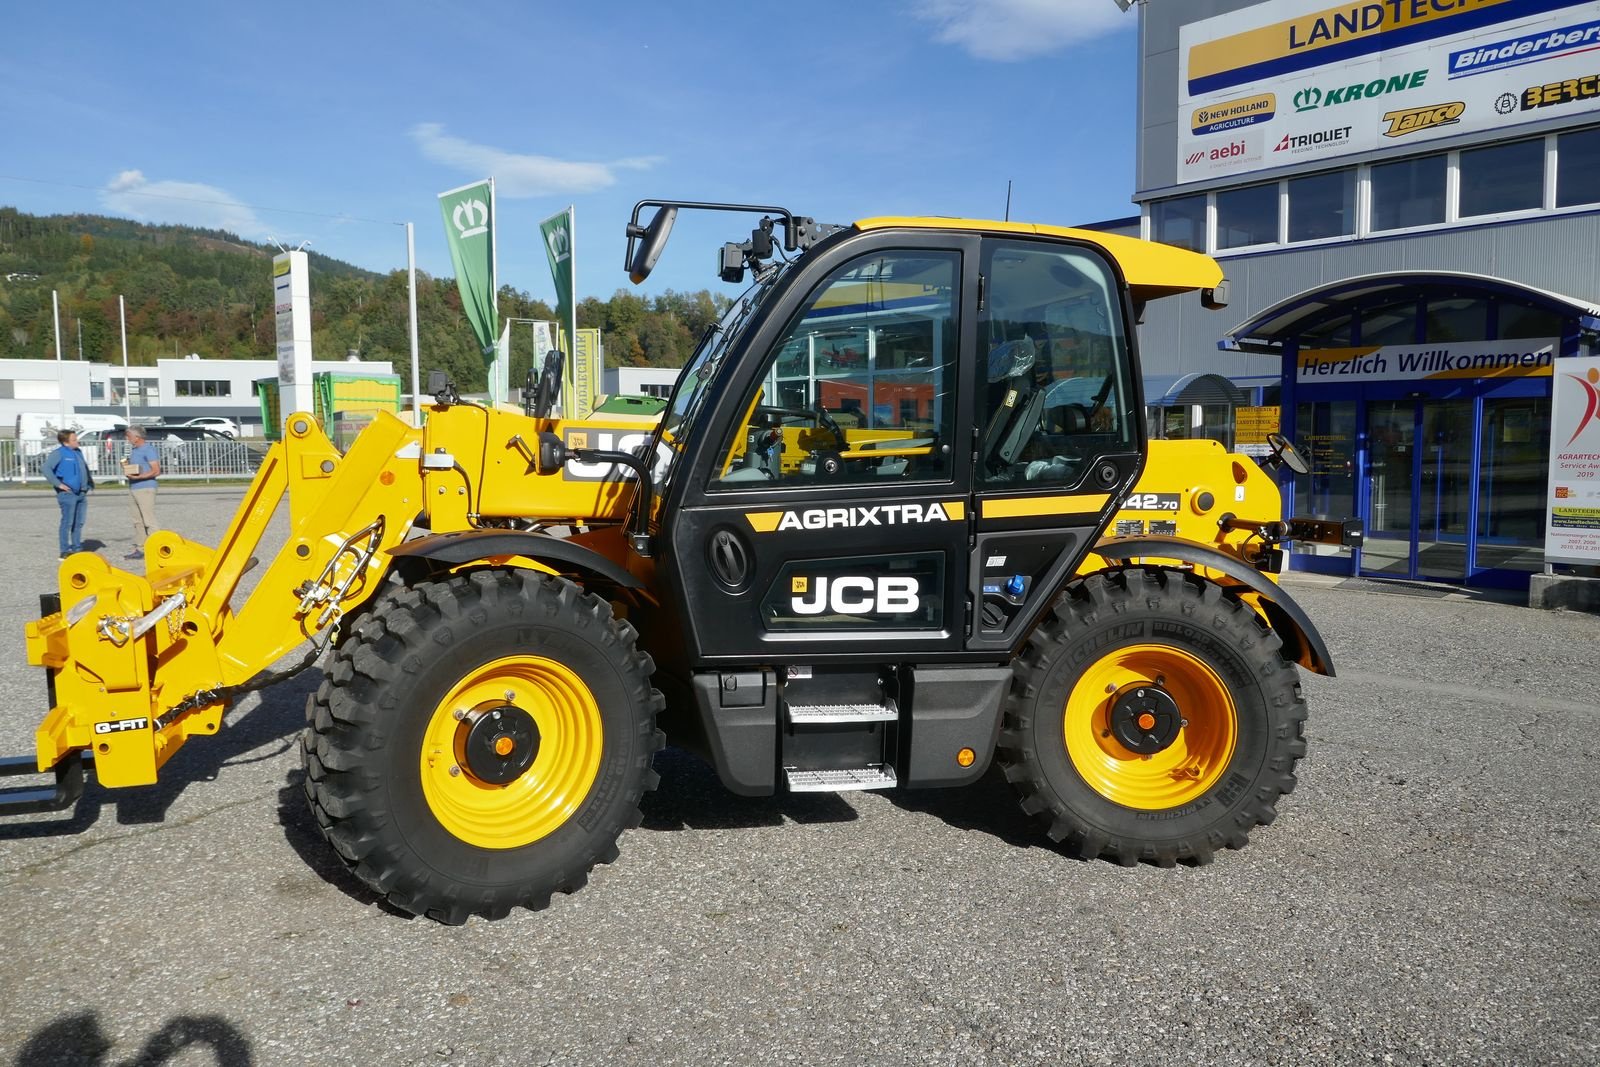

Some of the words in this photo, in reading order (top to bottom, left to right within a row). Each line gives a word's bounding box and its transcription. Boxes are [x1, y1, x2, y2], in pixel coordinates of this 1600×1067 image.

[1323, 69, 1429, 107] KRONE
[1210, 109, 1229, 120] NEW
[1230, 100, 1269, 115] HOLLAND
[1383, 102, 1465, 134] Tanco
[1209, 116, 1255, 132] AGRICULTURE
[1290, 126, 1353, 148] TRIOLIET
[1291, 145, 1313, 155] FEEDING
[1315, 139, 1350, 151] TECHNOLOGY
[1209, 140, 1246, 160] aebi
[1302, 353, 1388, 376] Herzlich
[1398, 349, 1553, 374] Willkommen
[778, 502, 949, 530] AGRIXTRA
[791, 576, 920, 614] JCB
